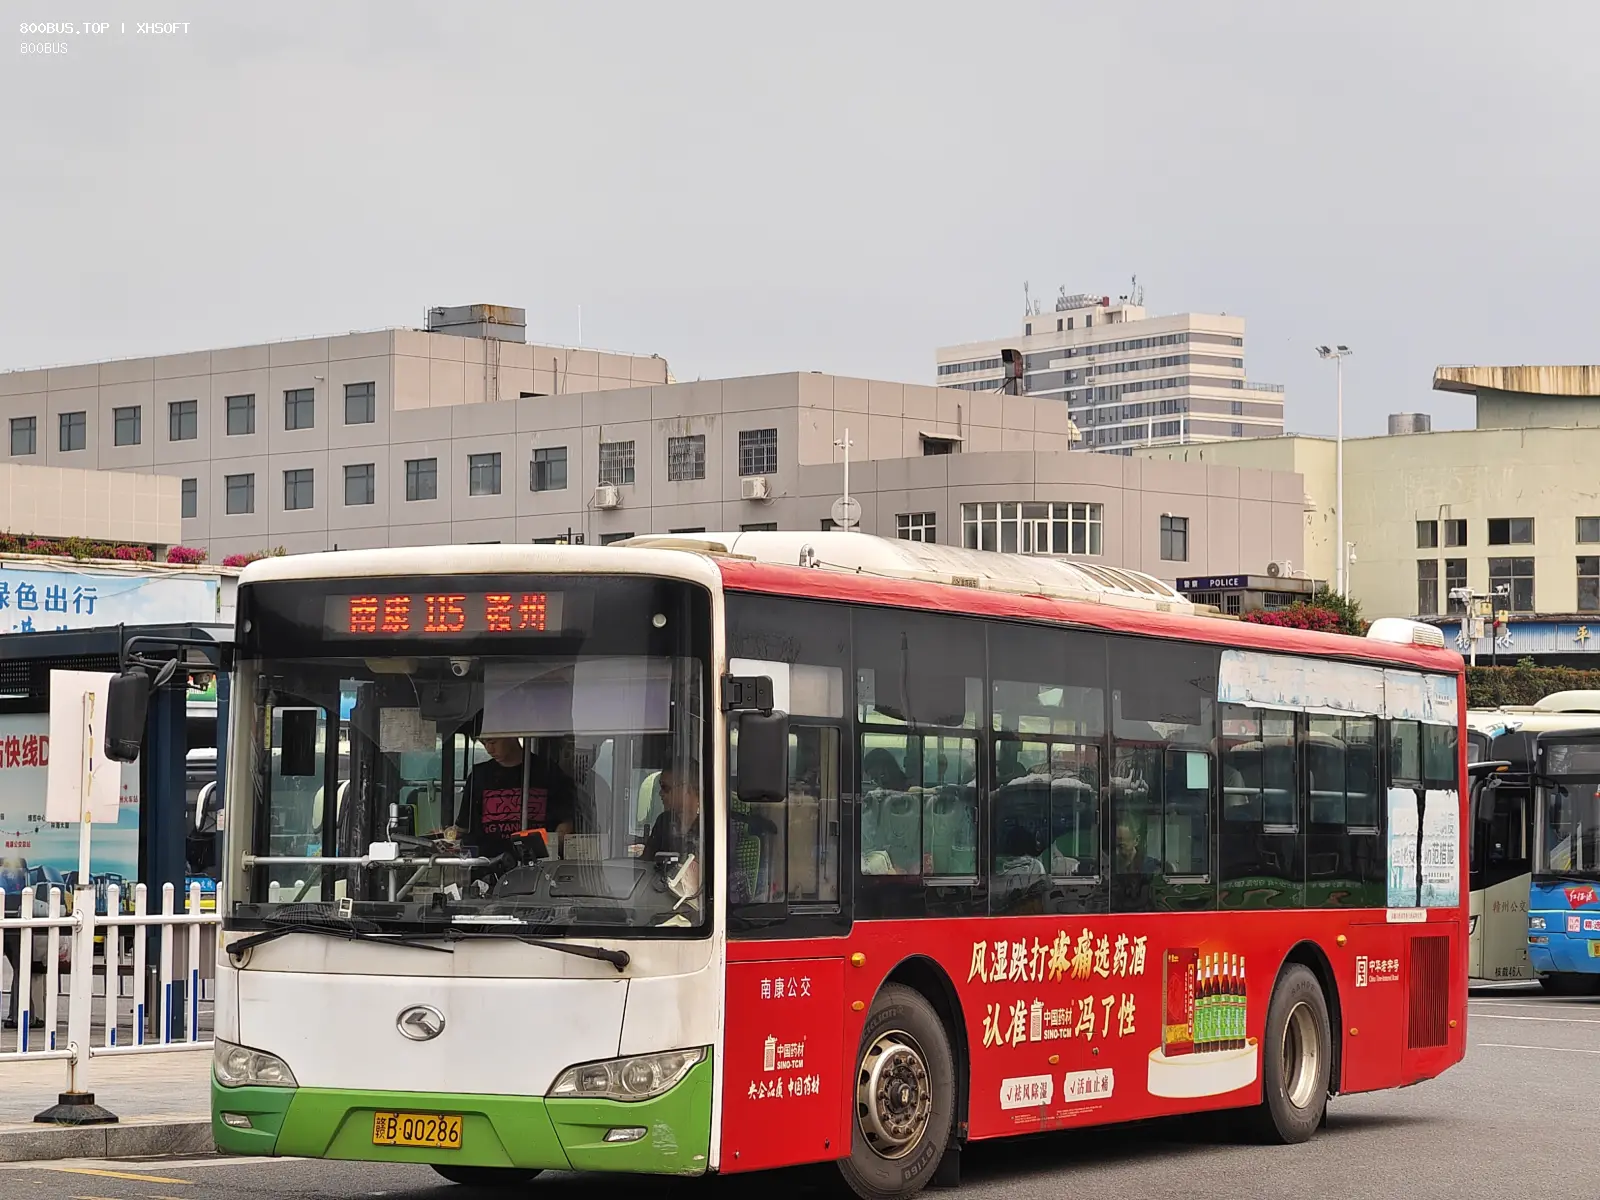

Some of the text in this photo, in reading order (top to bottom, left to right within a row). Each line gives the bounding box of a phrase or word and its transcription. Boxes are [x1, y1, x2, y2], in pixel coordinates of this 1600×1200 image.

[1209, 578, 1239, 588] POLICE
[349, 596, 411, 633] 南康
[424, 595, 466, 632] 115
[967, 928, 1147, 983] 风湿跌打疼痛选药酒
[760, 976, 811, 999] 南康公交
[982, 993, 1136, 1048] 认准 冯了性
[1044, 1008, 1072, 1026] 中国药材
[1044, 1028, 1072, 1039] SINO-TCM
[777, 1042, 804, 1058] 中国药材
[777, 1059, 803, 1070] SINO-TCM
[787, 1074, 820, 1097] 中国药材
[1077, 1075, 1109, 1095] 活血止痛
